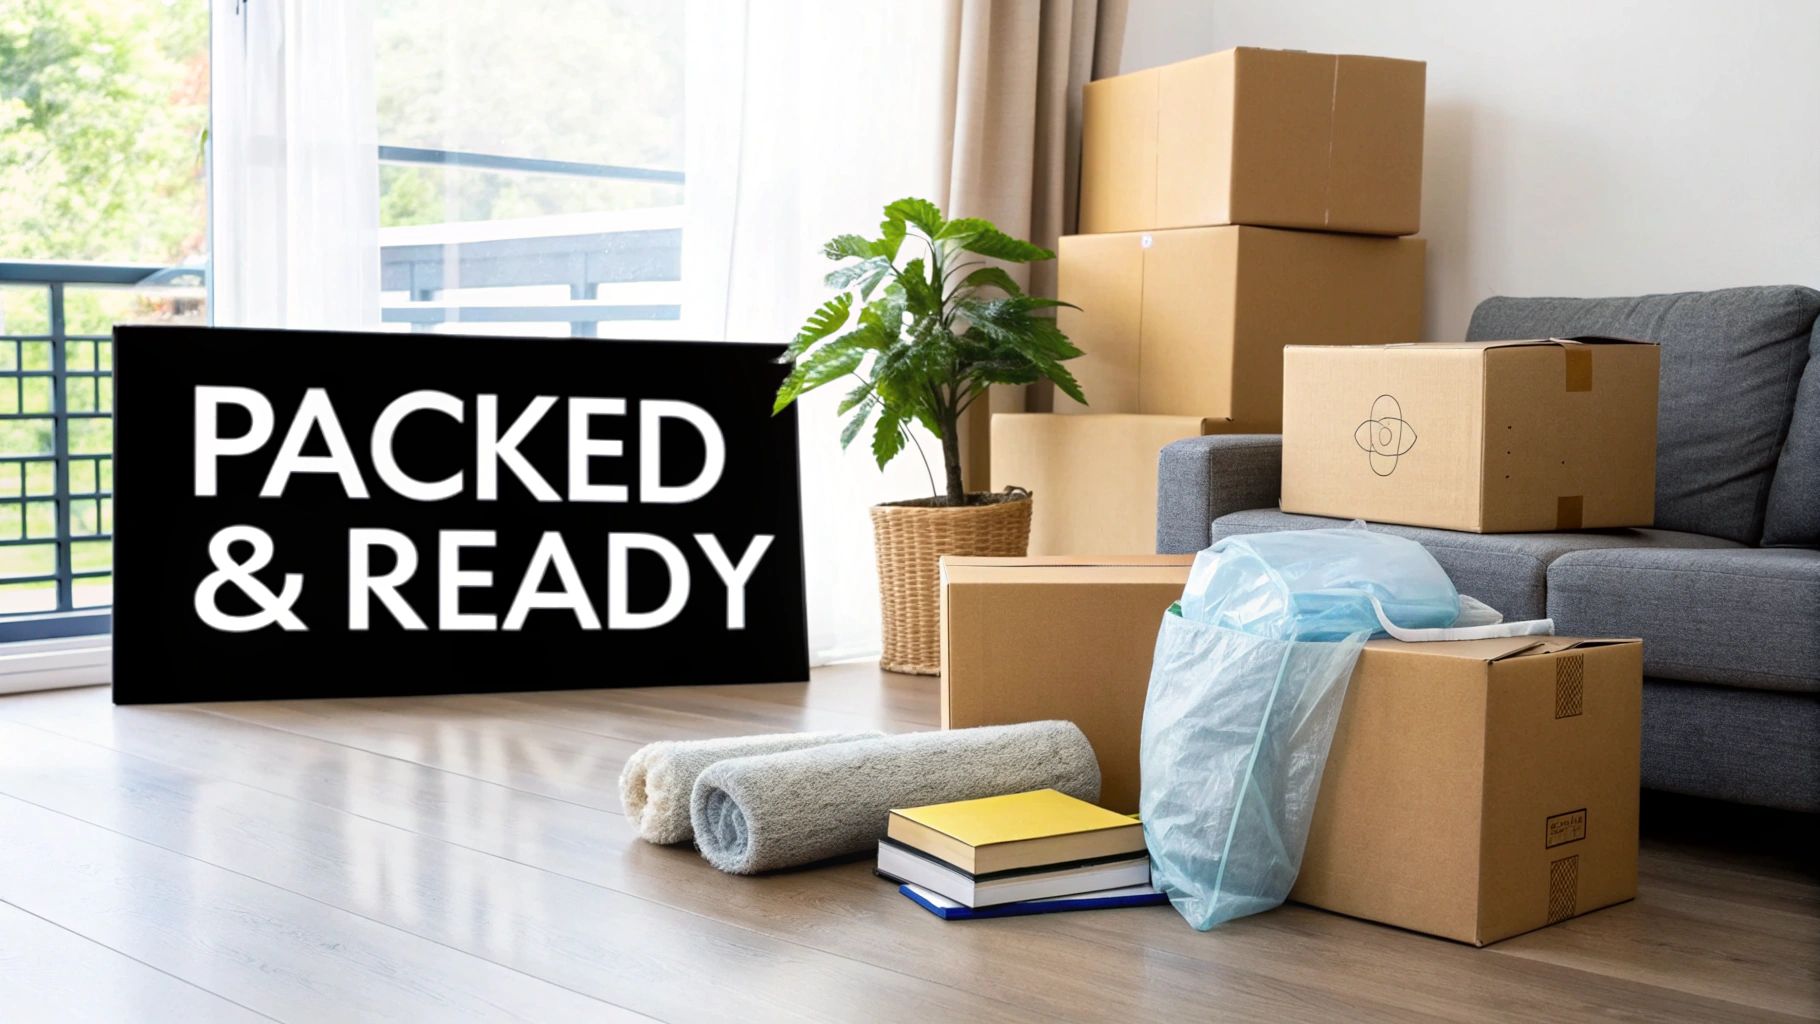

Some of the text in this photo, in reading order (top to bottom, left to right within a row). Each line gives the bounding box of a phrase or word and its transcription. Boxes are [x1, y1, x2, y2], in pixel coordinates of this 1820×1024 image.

[194, 385, 726, 504] PACKED
[194, 525, 775, 632] & READY
